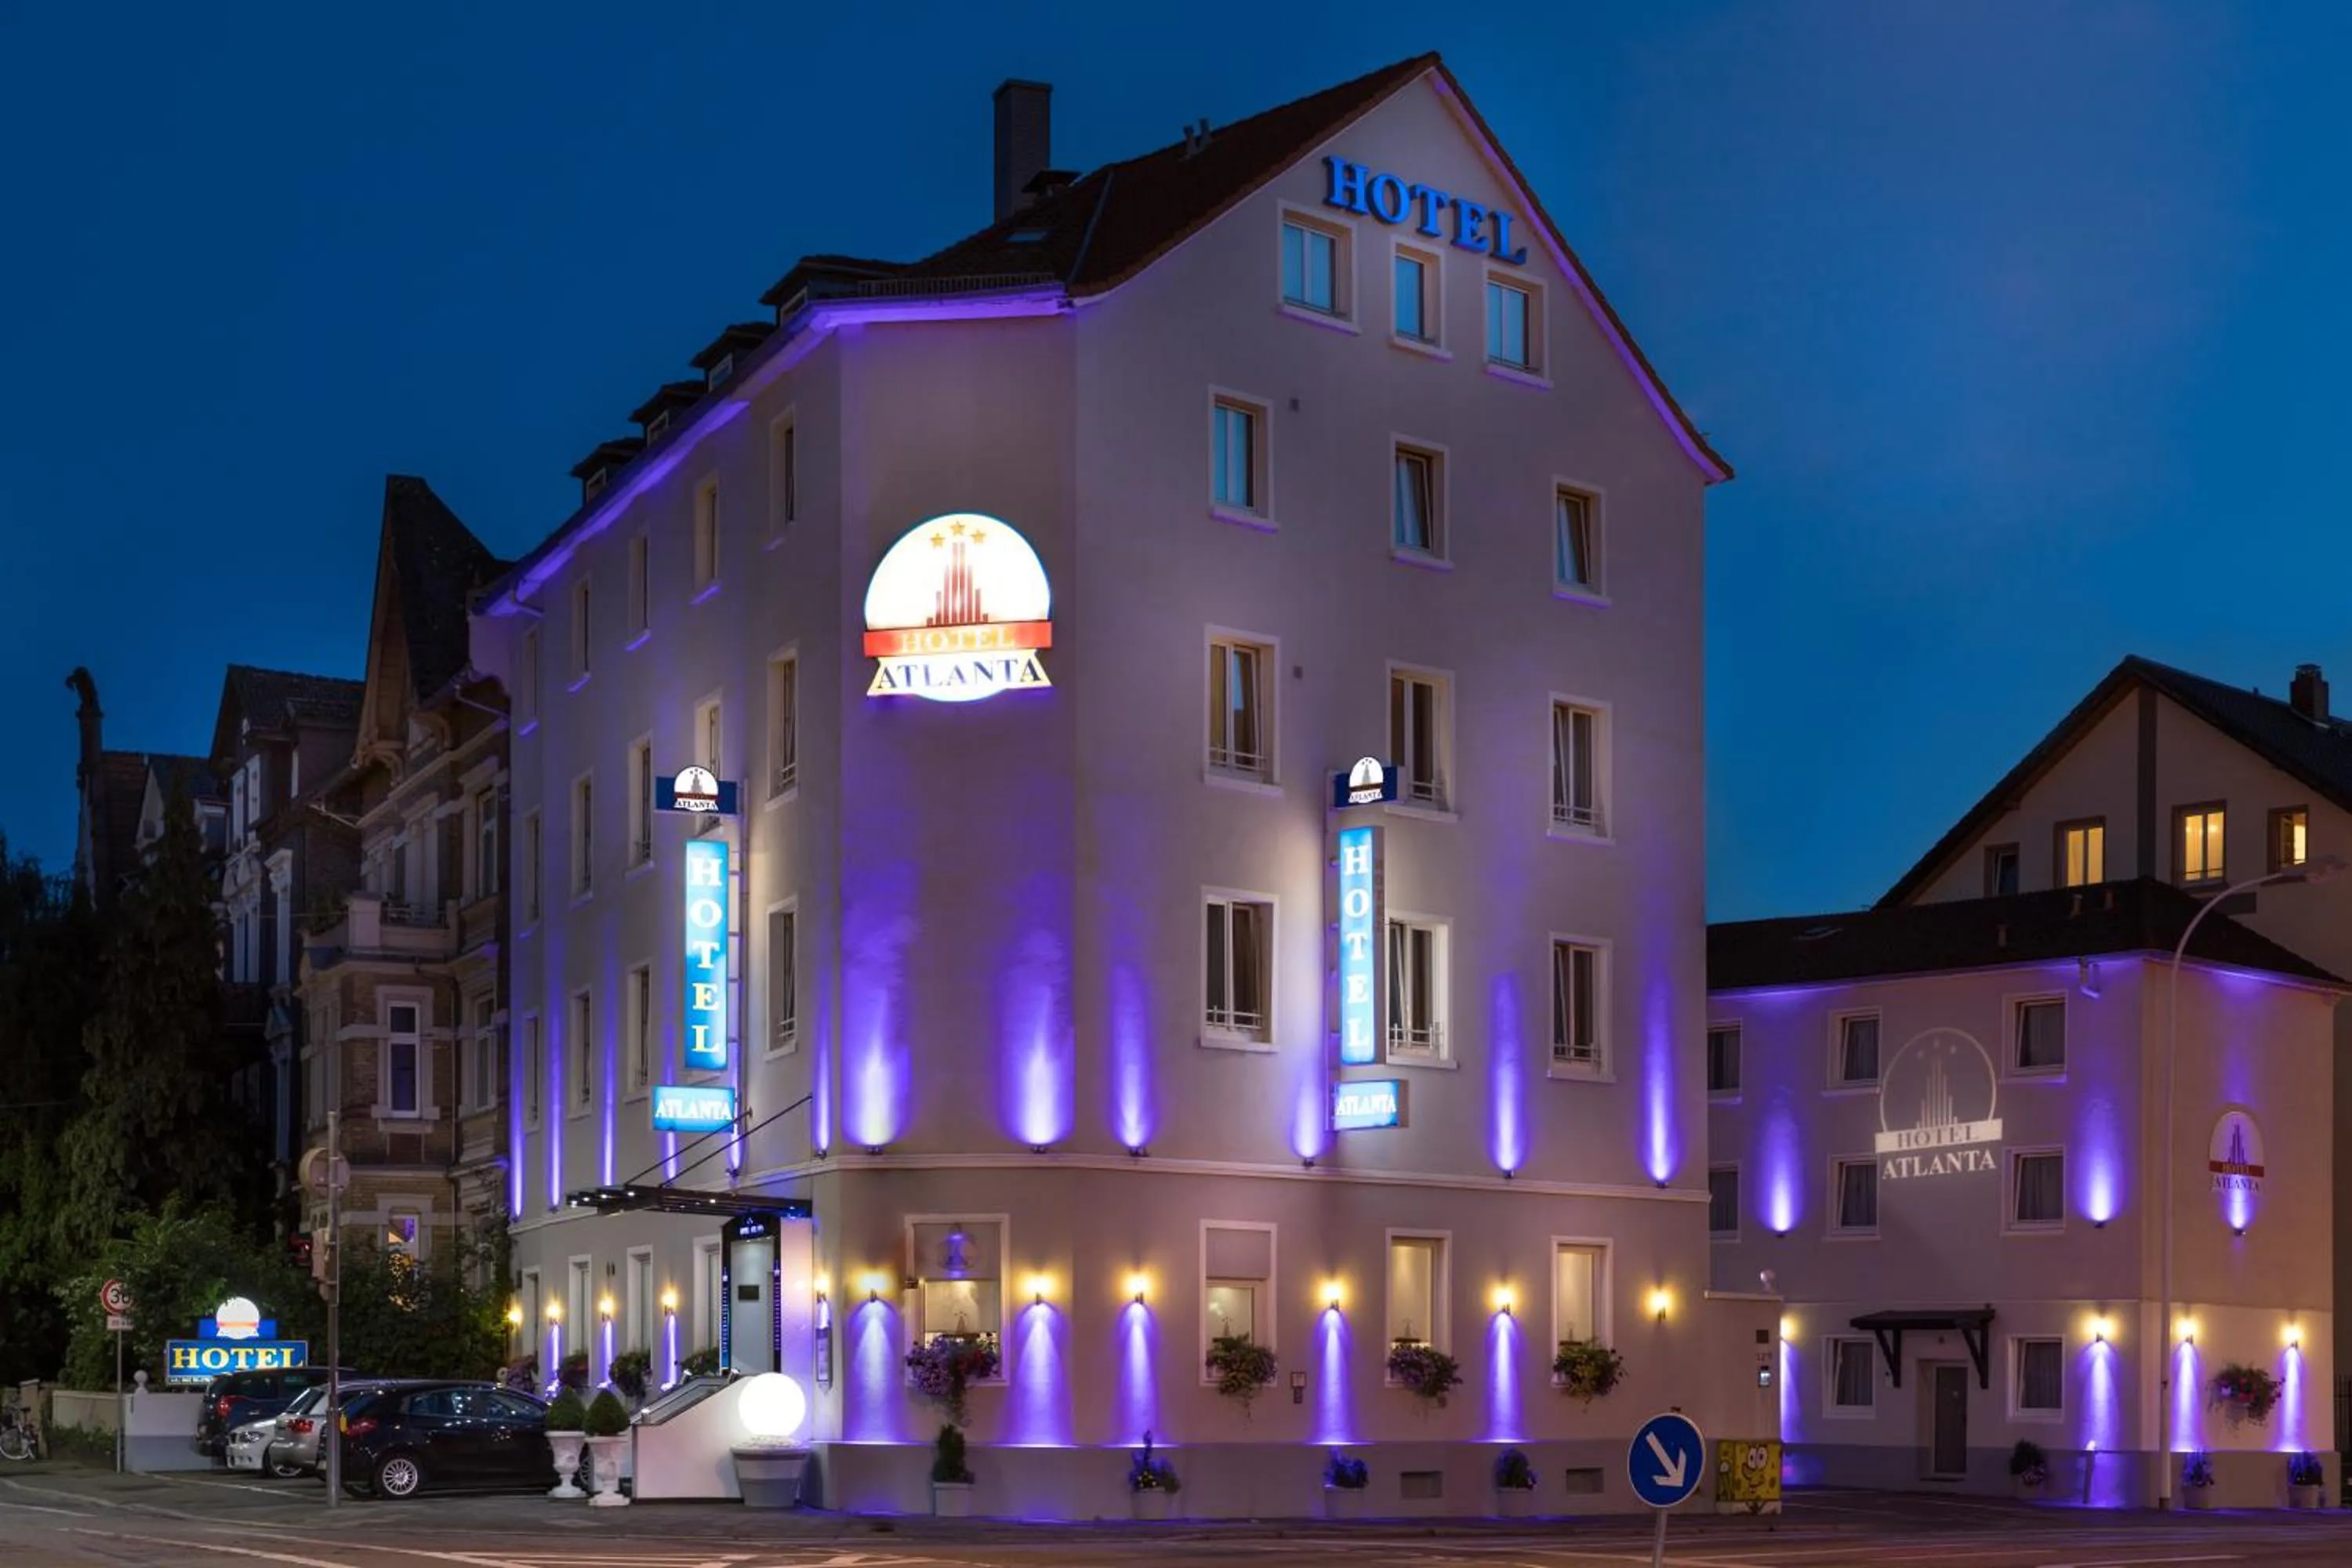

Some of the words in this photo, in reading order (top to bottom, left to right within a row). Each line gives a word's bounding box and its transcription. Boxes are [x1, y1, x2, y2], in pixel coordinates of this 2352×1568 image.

[1323, 154, 1527, 265] HOTEL
[902, 627, 1017, 655] HOTEL
[877, 658, 1042, 690] ATLANTA
[676, 800, 717, 810] ATLANTA
[689, 857, 723, 1053] HOTEL
[1343, 844, 1370, 1048] HOTEL
[655, 1098, 733, 1120] ATLANTA
[1336, 1094, 1396, 1116] ATLANTA
[1897, 1124, 1979, 1149] HOTEL
[1882, 1148, 1997, 1180] ATLANTA
[172, 1348, 304, 1369] HOTEL
